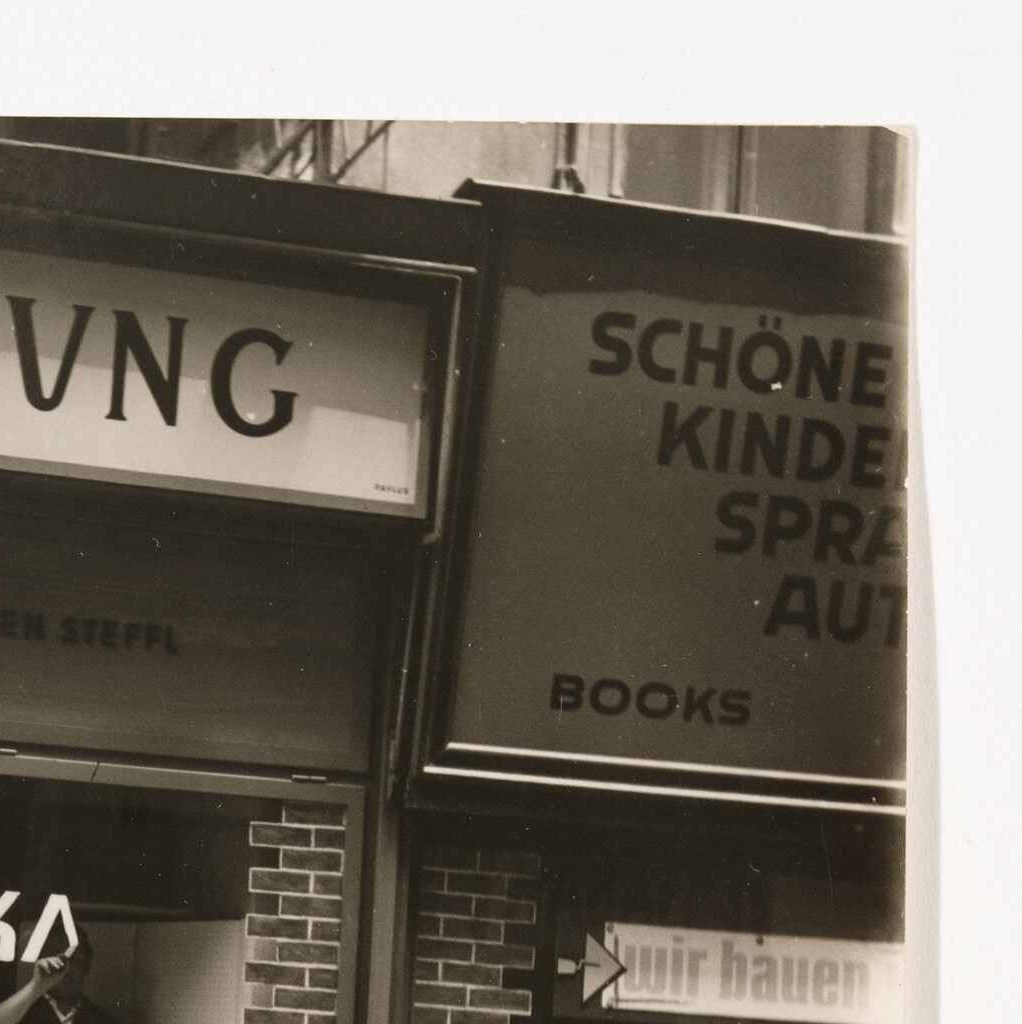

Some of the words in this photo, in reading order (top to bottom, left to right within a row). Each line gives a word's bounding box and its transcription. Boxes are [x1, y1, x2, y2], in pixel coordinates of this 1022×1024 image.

[588, 311, 894, 409] SCHÖNE
[656, 401, 907, 490] KINDE
[59, 615, 181, 655] STEFFL
[549, 673, 752, 726] BOOKS
[623, 935, 709, 999] wir
[721, 938, 870, 1009] bauen
